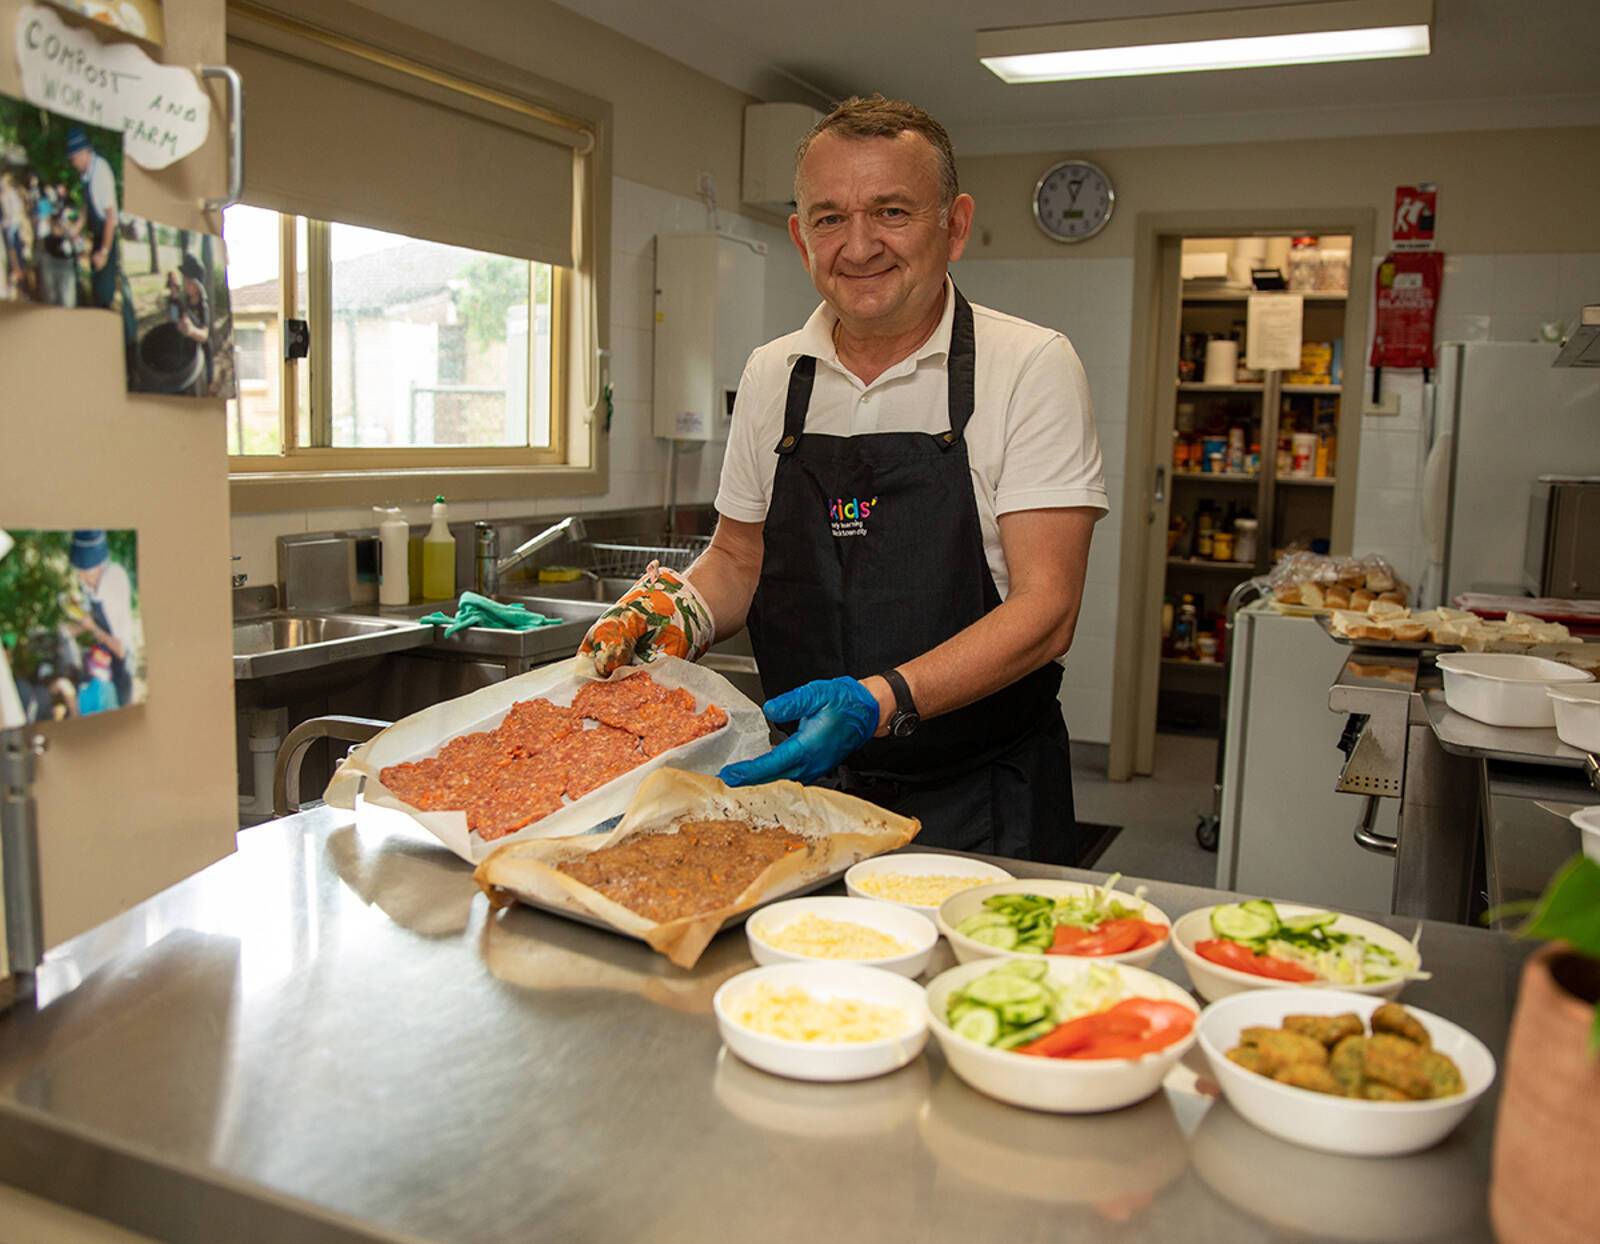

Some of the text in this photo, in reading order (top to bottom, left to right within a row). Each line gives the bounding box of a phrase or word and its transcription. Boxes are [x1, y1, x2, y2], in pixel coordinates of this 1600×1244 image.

[25, 19, 197, 122] COMPOST AND
[42, 73, 178, 156] WORM FARM
